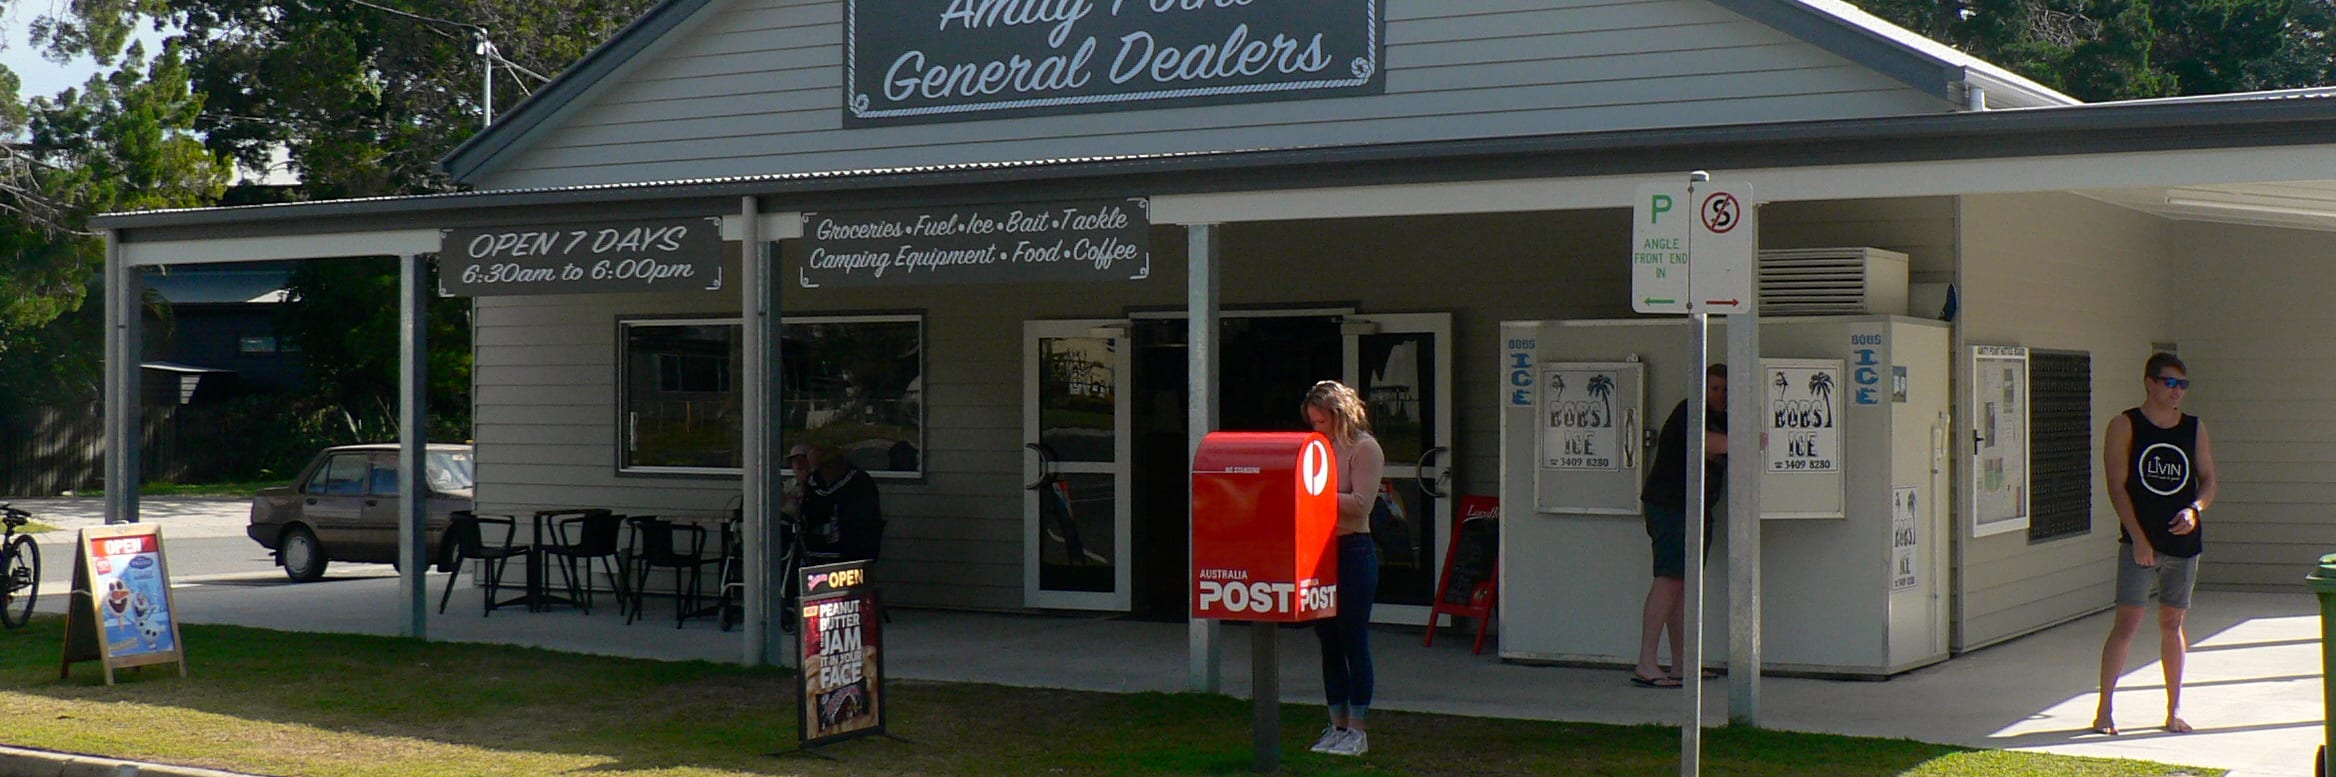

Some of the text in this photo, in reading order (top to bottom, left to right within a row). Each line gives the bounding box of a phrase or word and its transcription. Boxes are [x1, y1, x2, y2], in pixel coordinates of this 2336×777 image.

[883, 24, 1332, 101] General Dealers
[1651, 194, 1673, 224] P
[817, 206, 1129, 241] Groceries Fuel Ice Bait Tackle
[468, 225, 688, 258] OPEN 7 DAYS
[1643, 237, 1680, 250] ANGLE
[462, 258, 695, 284] 6:30am to 6:00pm
[809, 238, 1138, 278] Camping Equipment Food Coffee
[1634, 252, 1688, 265] FRONT END
[1655, 267, 1667, 278] IN
[1511, 353, 1533, 405] ICE
[1854, 349, 1879, 405] ICE
[1564, 431, 1594, 455] ICE
[1788, 431, 1817, 457] ICE
[1784, 460, 1806, 469] 3409
[2147, 455, 2181, 476] LIVIN
[104, 538, 142, 555] OPEN
[828, 569, 864, 588] OPEN
[1200, 570, 1248, 579] AUSTRALIA
[820, 600, 860, 617] PEANUT
[1200, 581, 1296, 613] POST
[1300, 585, 1337, 612] POST
[820, 613, 860, 631] BUTTER
[820, 626, 862, 655] JAM
[820, 662, 863, 689] FACE
